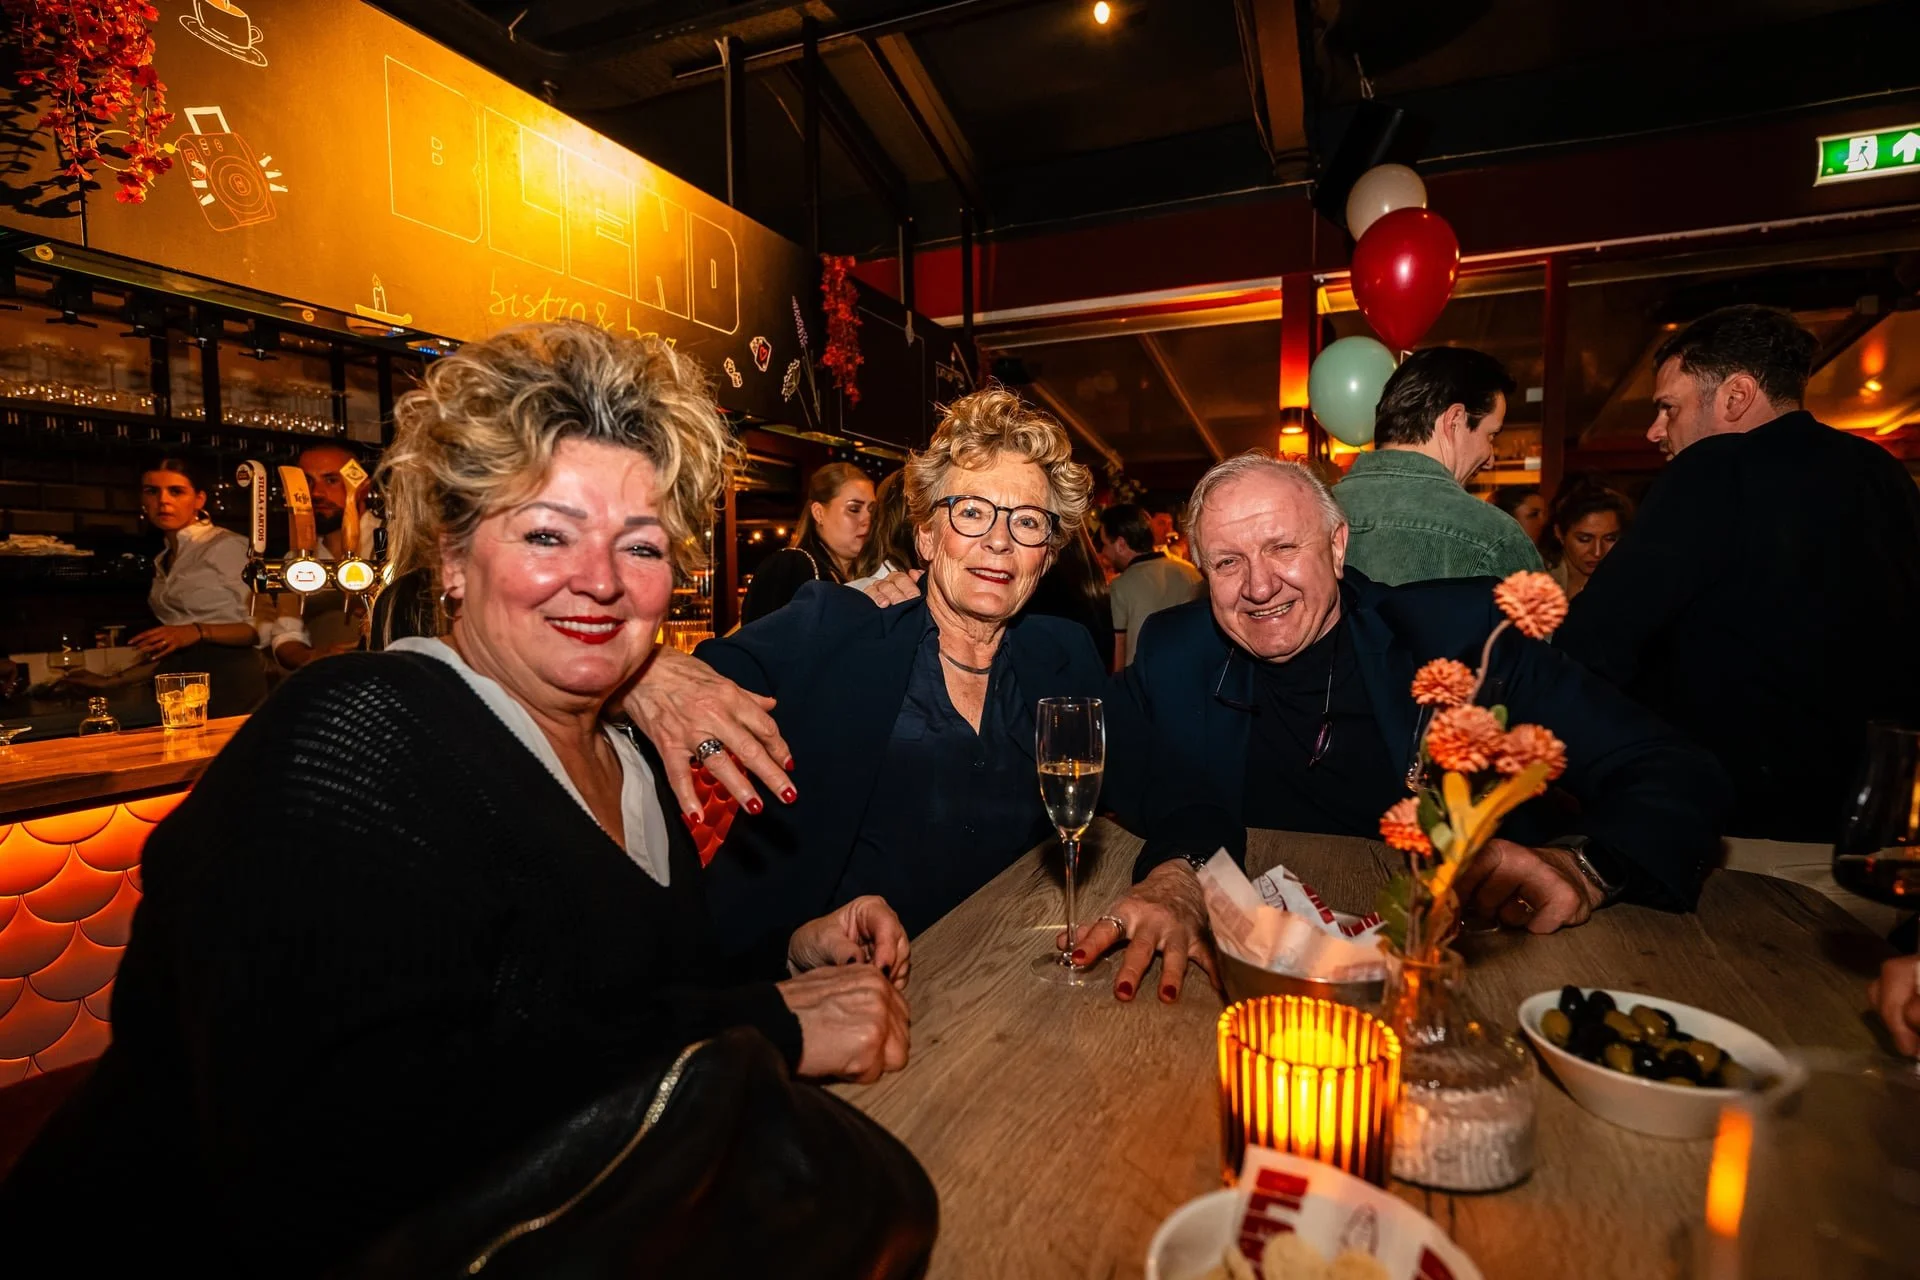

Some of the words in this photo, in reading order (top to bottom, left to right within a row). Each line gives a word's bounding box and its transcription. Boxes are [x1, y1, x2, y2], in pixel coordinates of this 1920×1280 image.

[384, 54, 740, 336] BLEND
[257, 475, 266, 504] STELLA
[257, 511, 266, 542] ARTOIS
